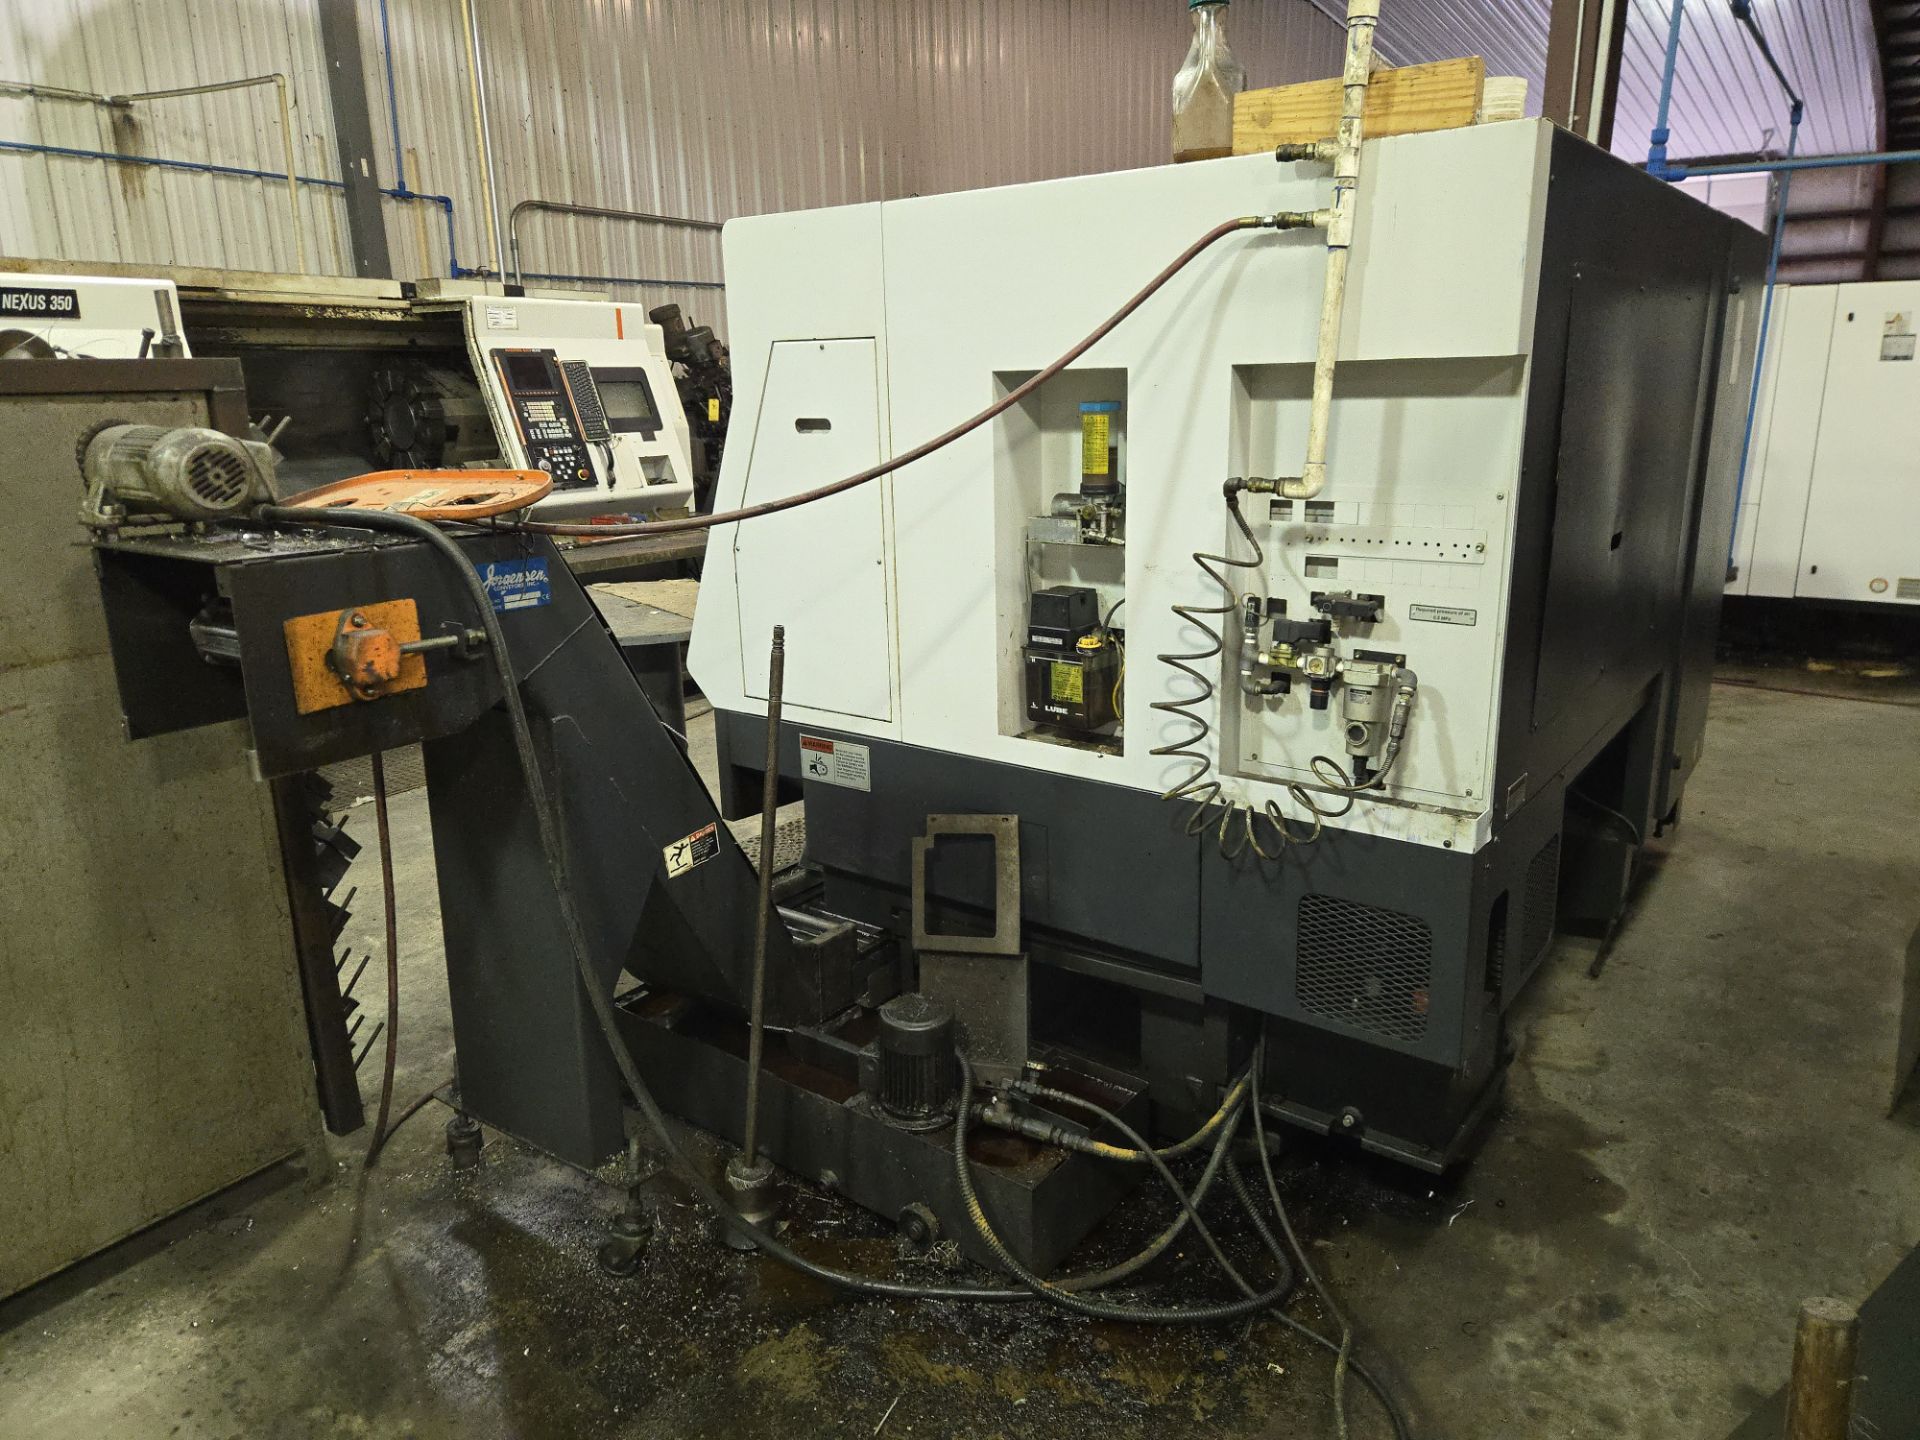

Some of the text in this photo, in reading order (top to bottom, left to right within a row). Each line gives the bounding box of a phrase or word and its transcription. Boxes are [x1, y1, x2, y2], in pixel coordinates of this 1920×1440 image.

[2, 293, 73, 311] NEXUS 350
[483, 564, 545, 593] Jorgensen
[1044, 705, 1068, 715] LUBE
